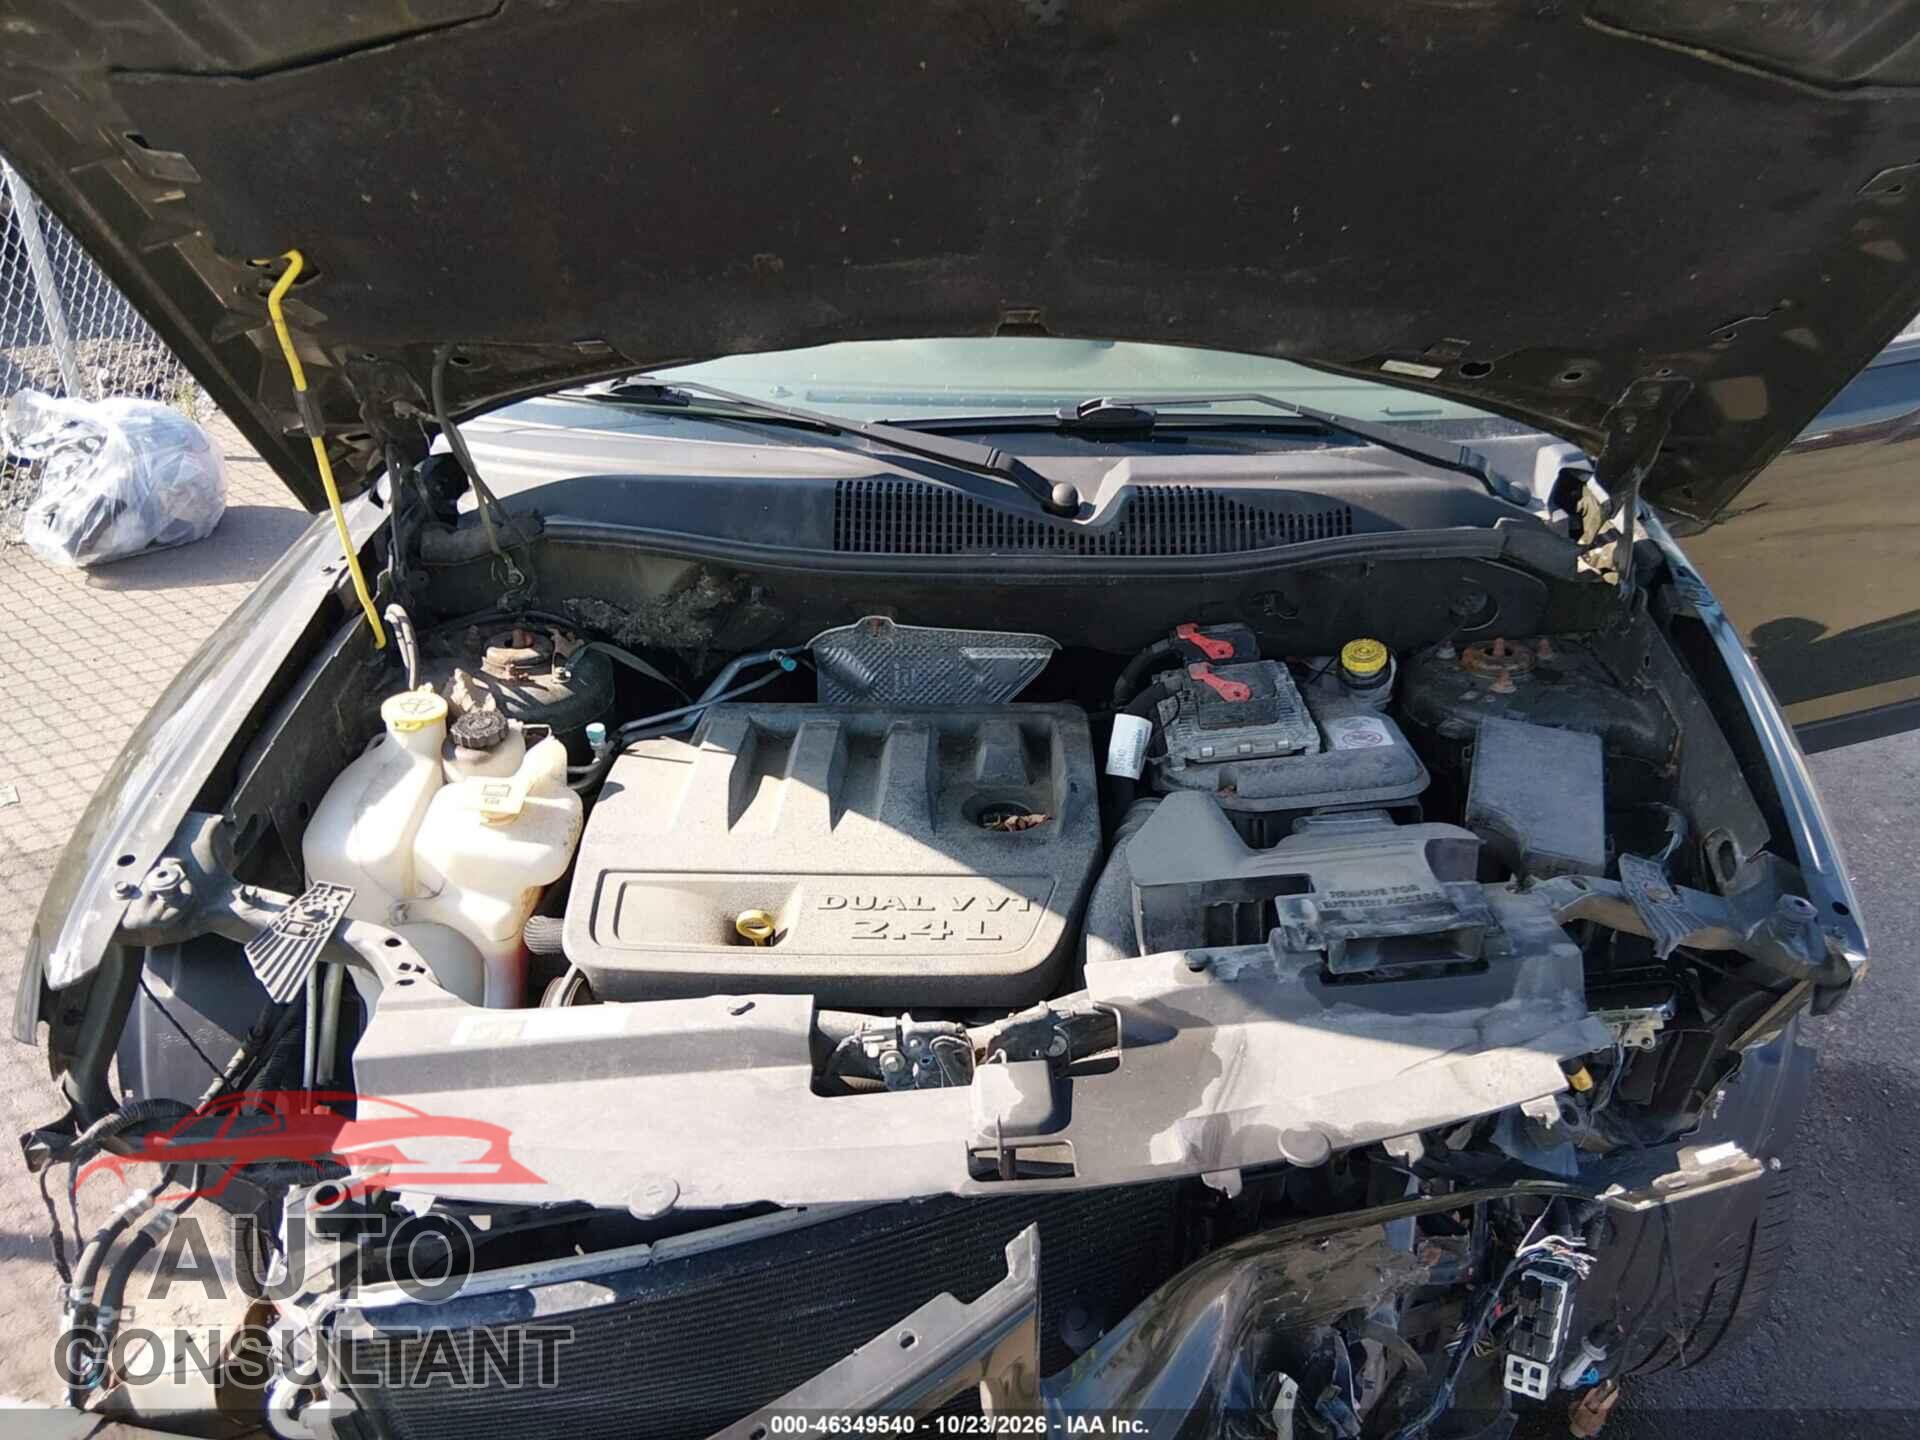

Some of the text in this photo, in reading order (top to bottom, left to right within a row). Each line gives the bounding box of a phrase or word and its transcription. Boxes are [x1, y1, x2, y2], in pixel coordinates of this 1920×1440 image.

[817, 894, 1038, 912] DUAL VVT
[850, 919, 1002, 941] 2.4L
